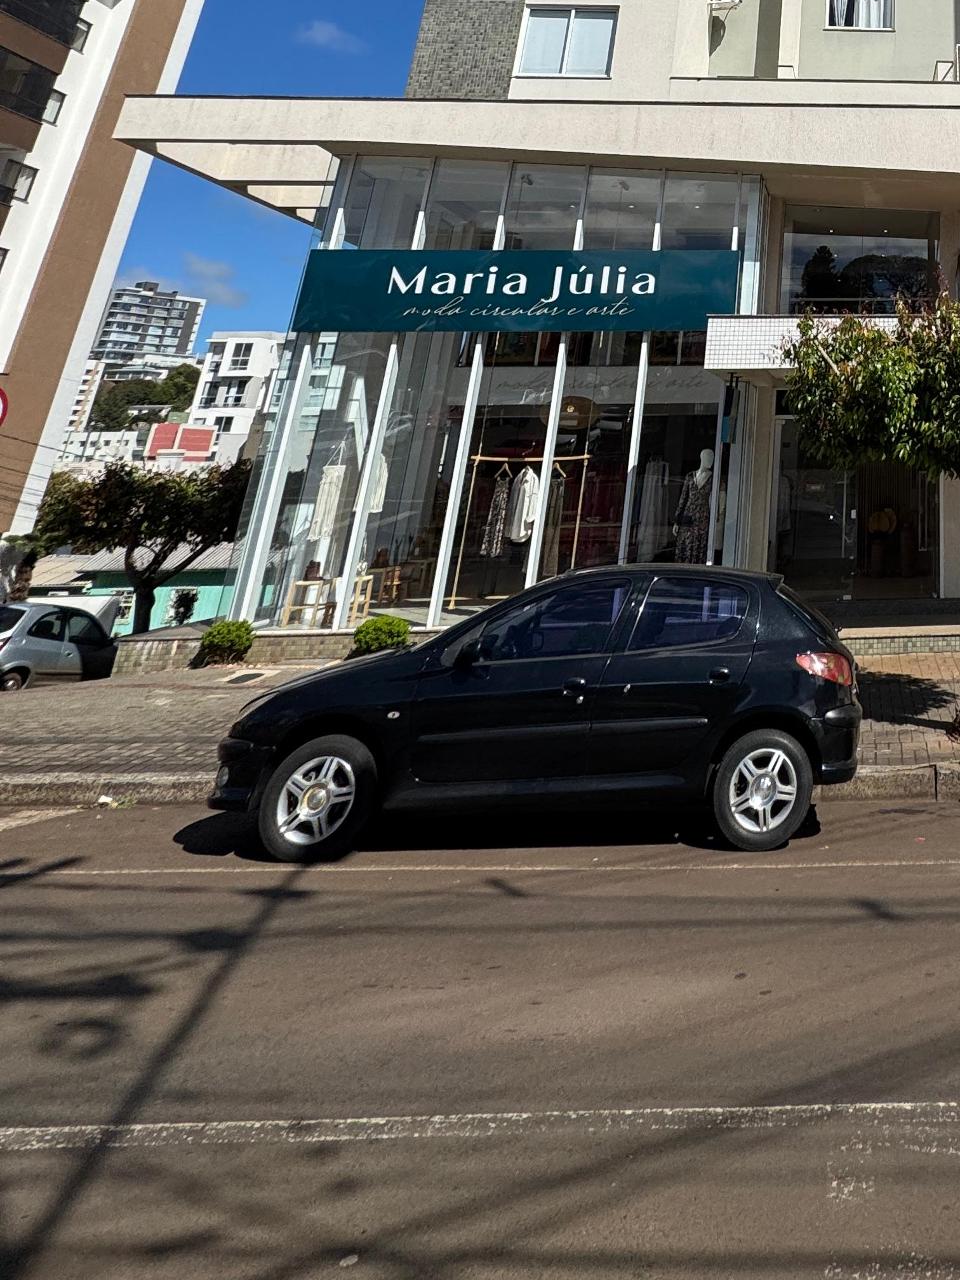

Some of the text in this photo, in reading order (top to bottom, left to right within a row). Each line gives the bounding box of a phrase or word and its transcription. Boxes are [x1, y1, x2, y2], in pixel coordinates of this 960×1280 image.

[387, 265, 656, 303] Maria Júlia
[403, 296, 636, 316] moda circular e arte
